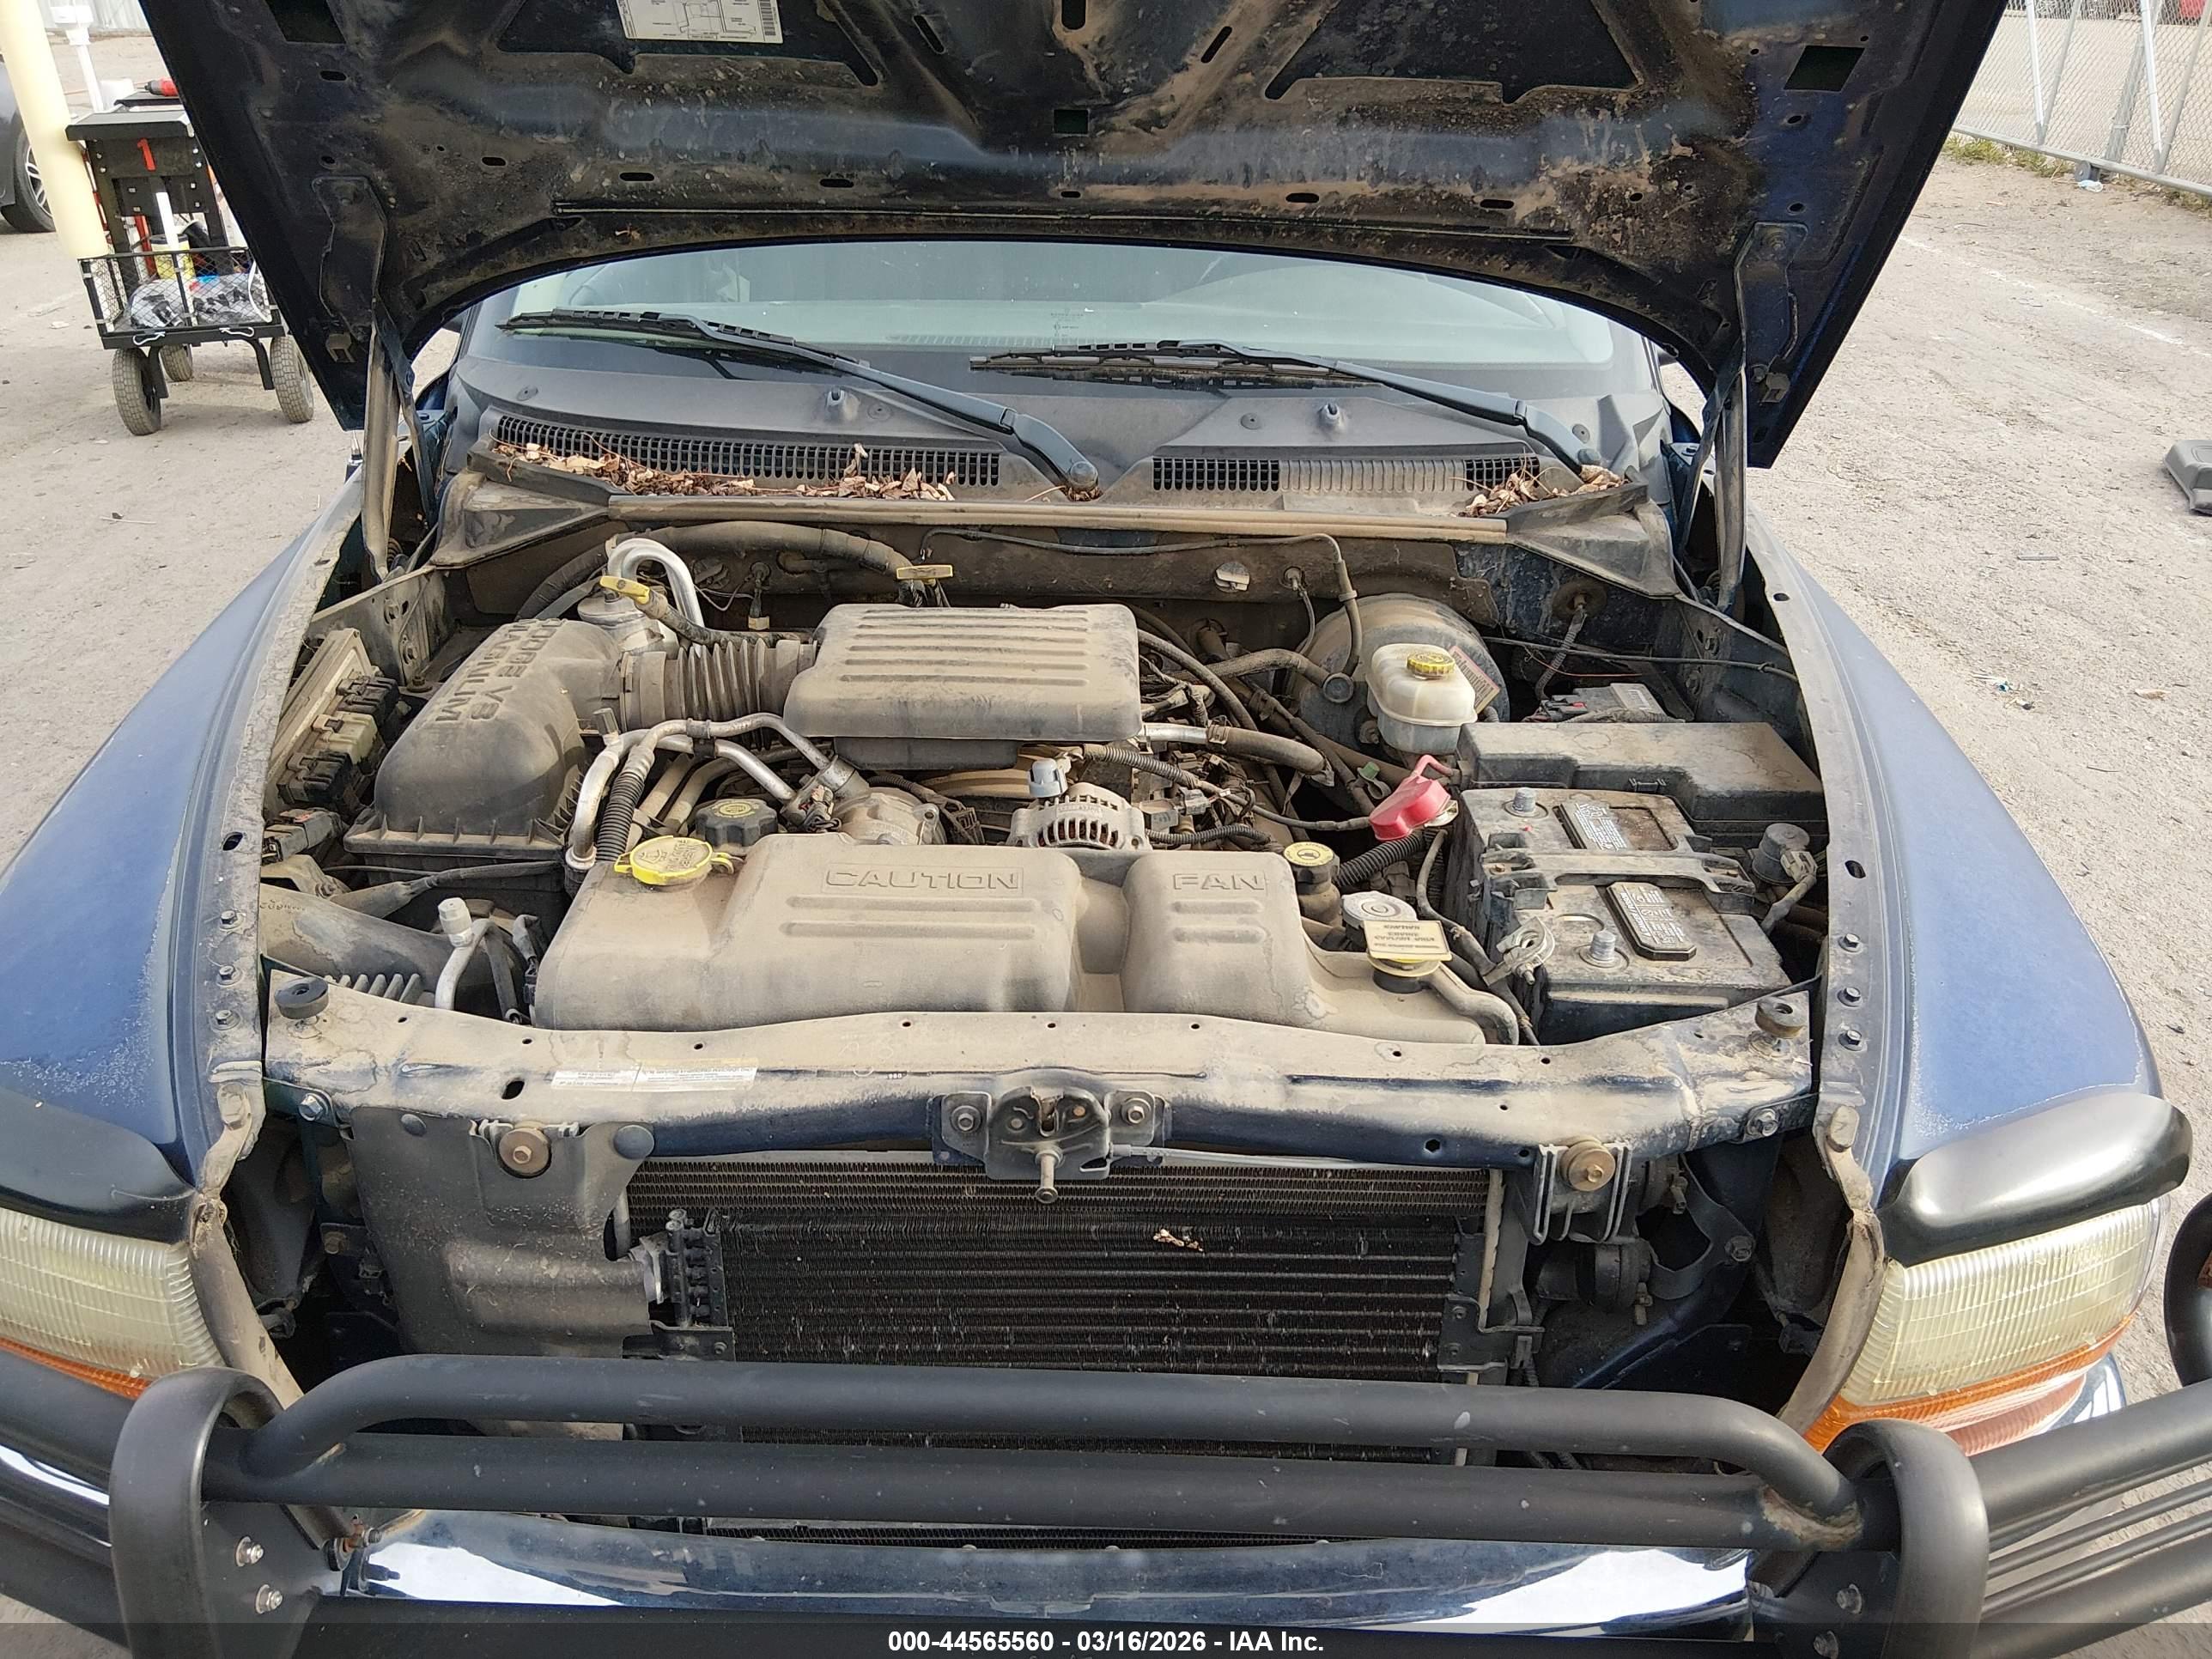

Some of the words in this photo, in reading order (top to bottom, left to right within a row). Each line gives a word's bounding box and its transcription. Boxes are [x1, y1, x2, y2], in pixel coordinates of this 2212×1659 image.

[137, 138, 155, 171] 1
[470, 685, 514, 720] V8
[825, 870, 1019, 890] CAUTION
[1172, 873, 1265, 890] FAN
